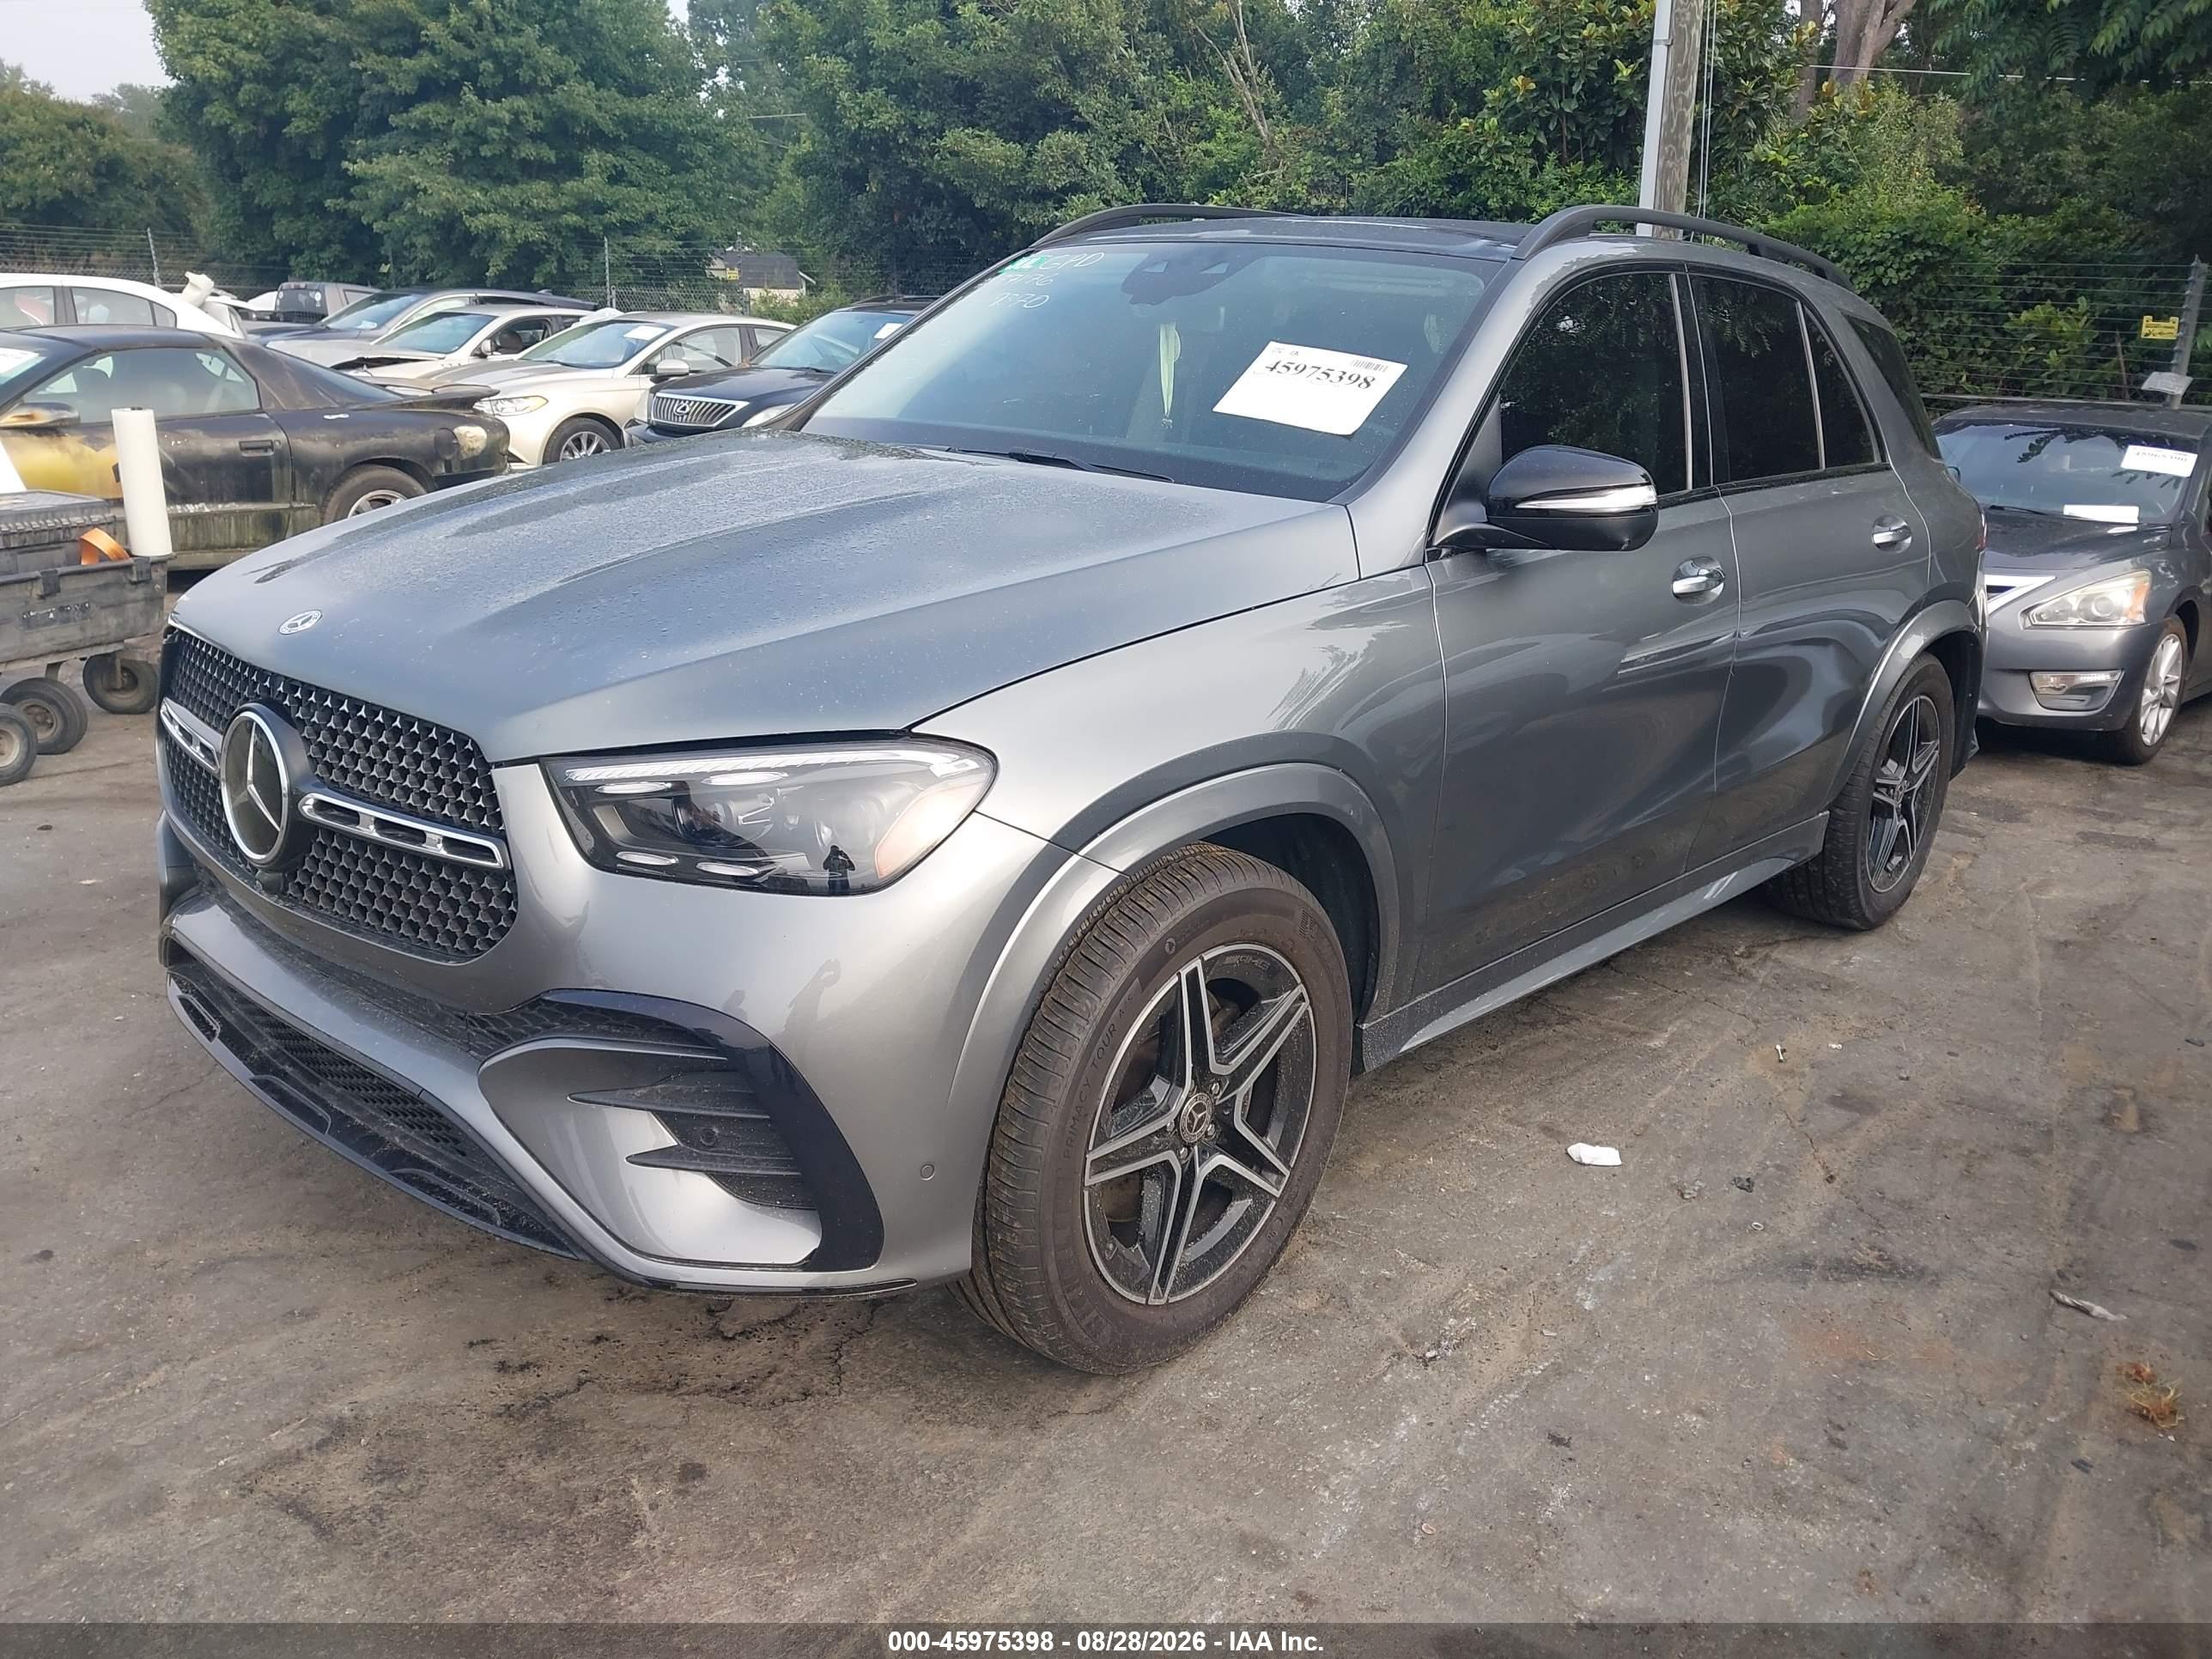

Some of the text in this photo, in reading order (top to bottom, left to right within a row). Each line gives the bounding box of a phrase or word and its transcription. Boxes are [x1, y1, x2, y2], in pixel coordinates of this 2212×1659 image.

[1265, 360, 1376, 390] 45975398
[1063, 1081, 1091, 1159] PRIMACY
[1091, 1023, 1116, 1070] TOUR
